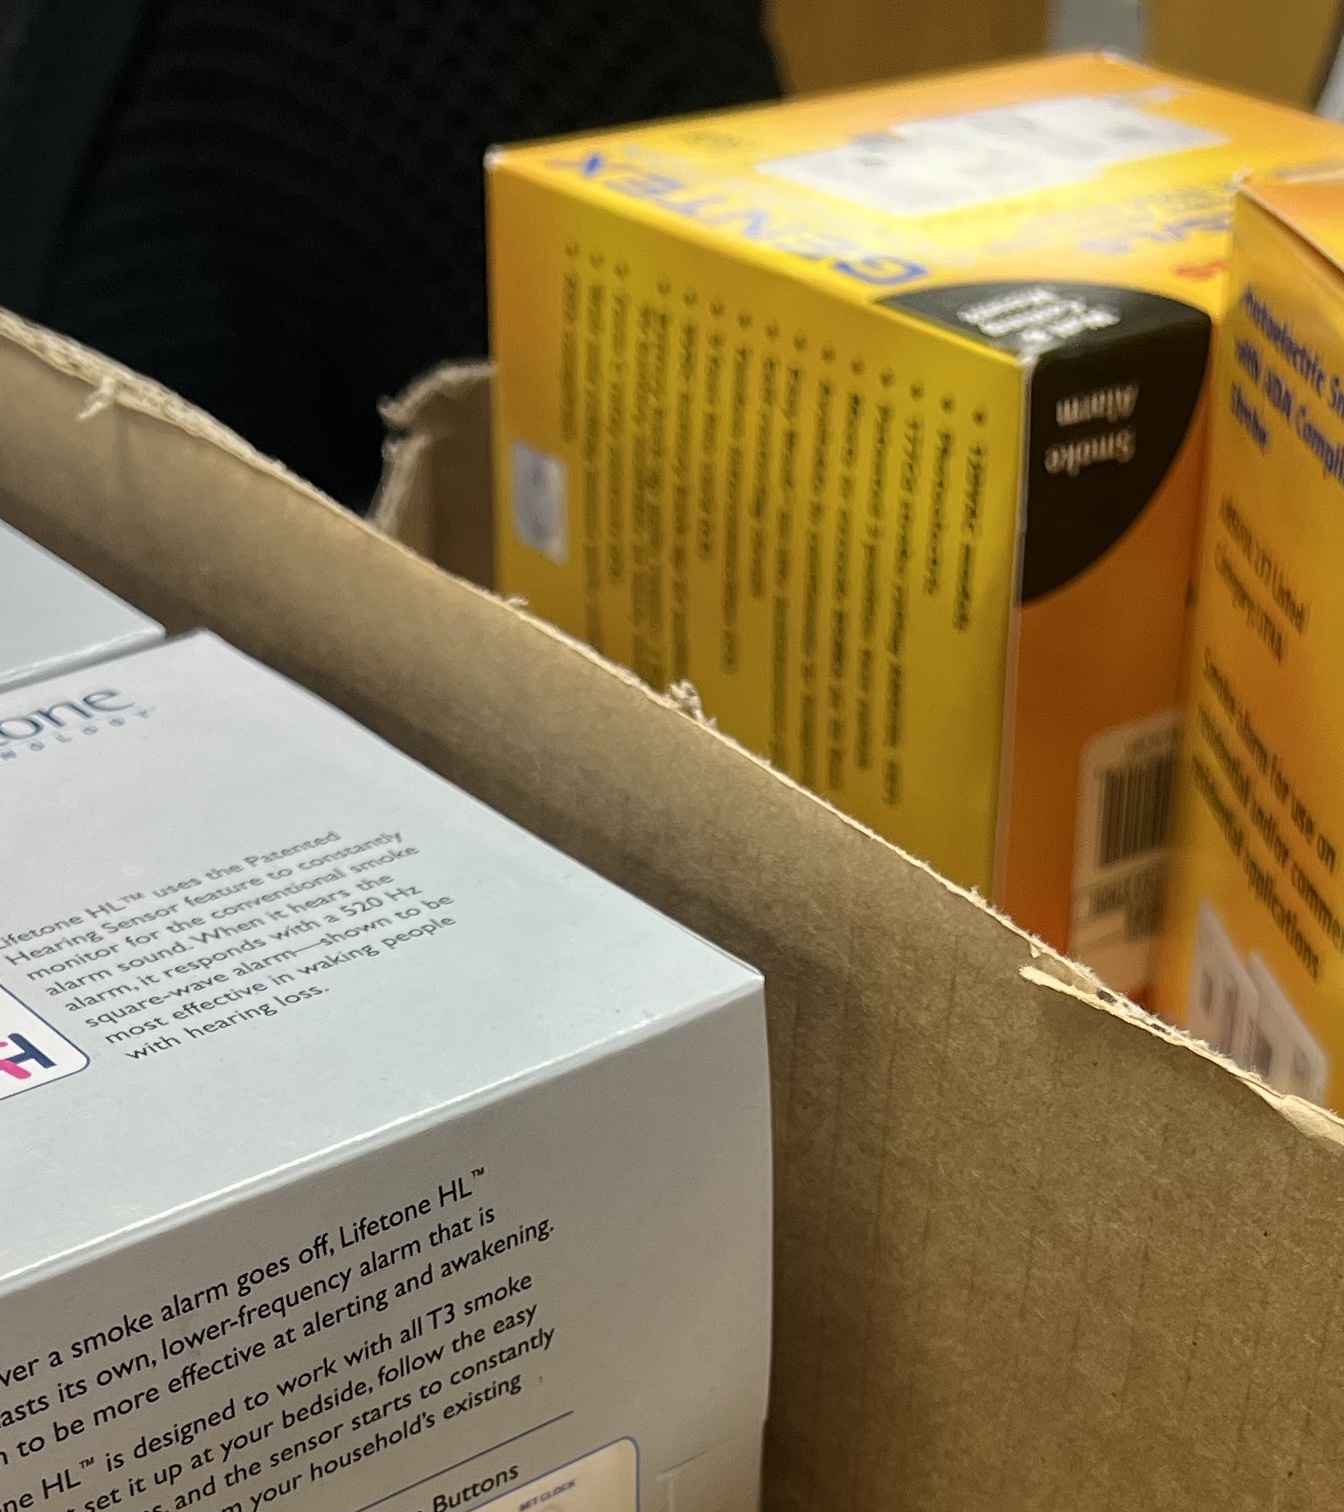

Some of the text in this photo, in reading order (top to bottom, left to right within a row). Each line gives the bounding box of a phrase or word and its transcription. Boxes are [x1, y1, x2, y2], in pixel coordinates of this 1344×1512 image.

[1056, 381, 1140, 426] Alarm
[1044, 425, 1137, 477] Smoke
[48, 1350, 64, 1367] a
[70, 1313, 153, 1358] smoke
[160, 1282, 228, 1322] alarm
[236, 1256, 290, 1297] goes
[298, 1232, 335, 1264] off,
[339, 1198, 431, 1248] Lifetone
